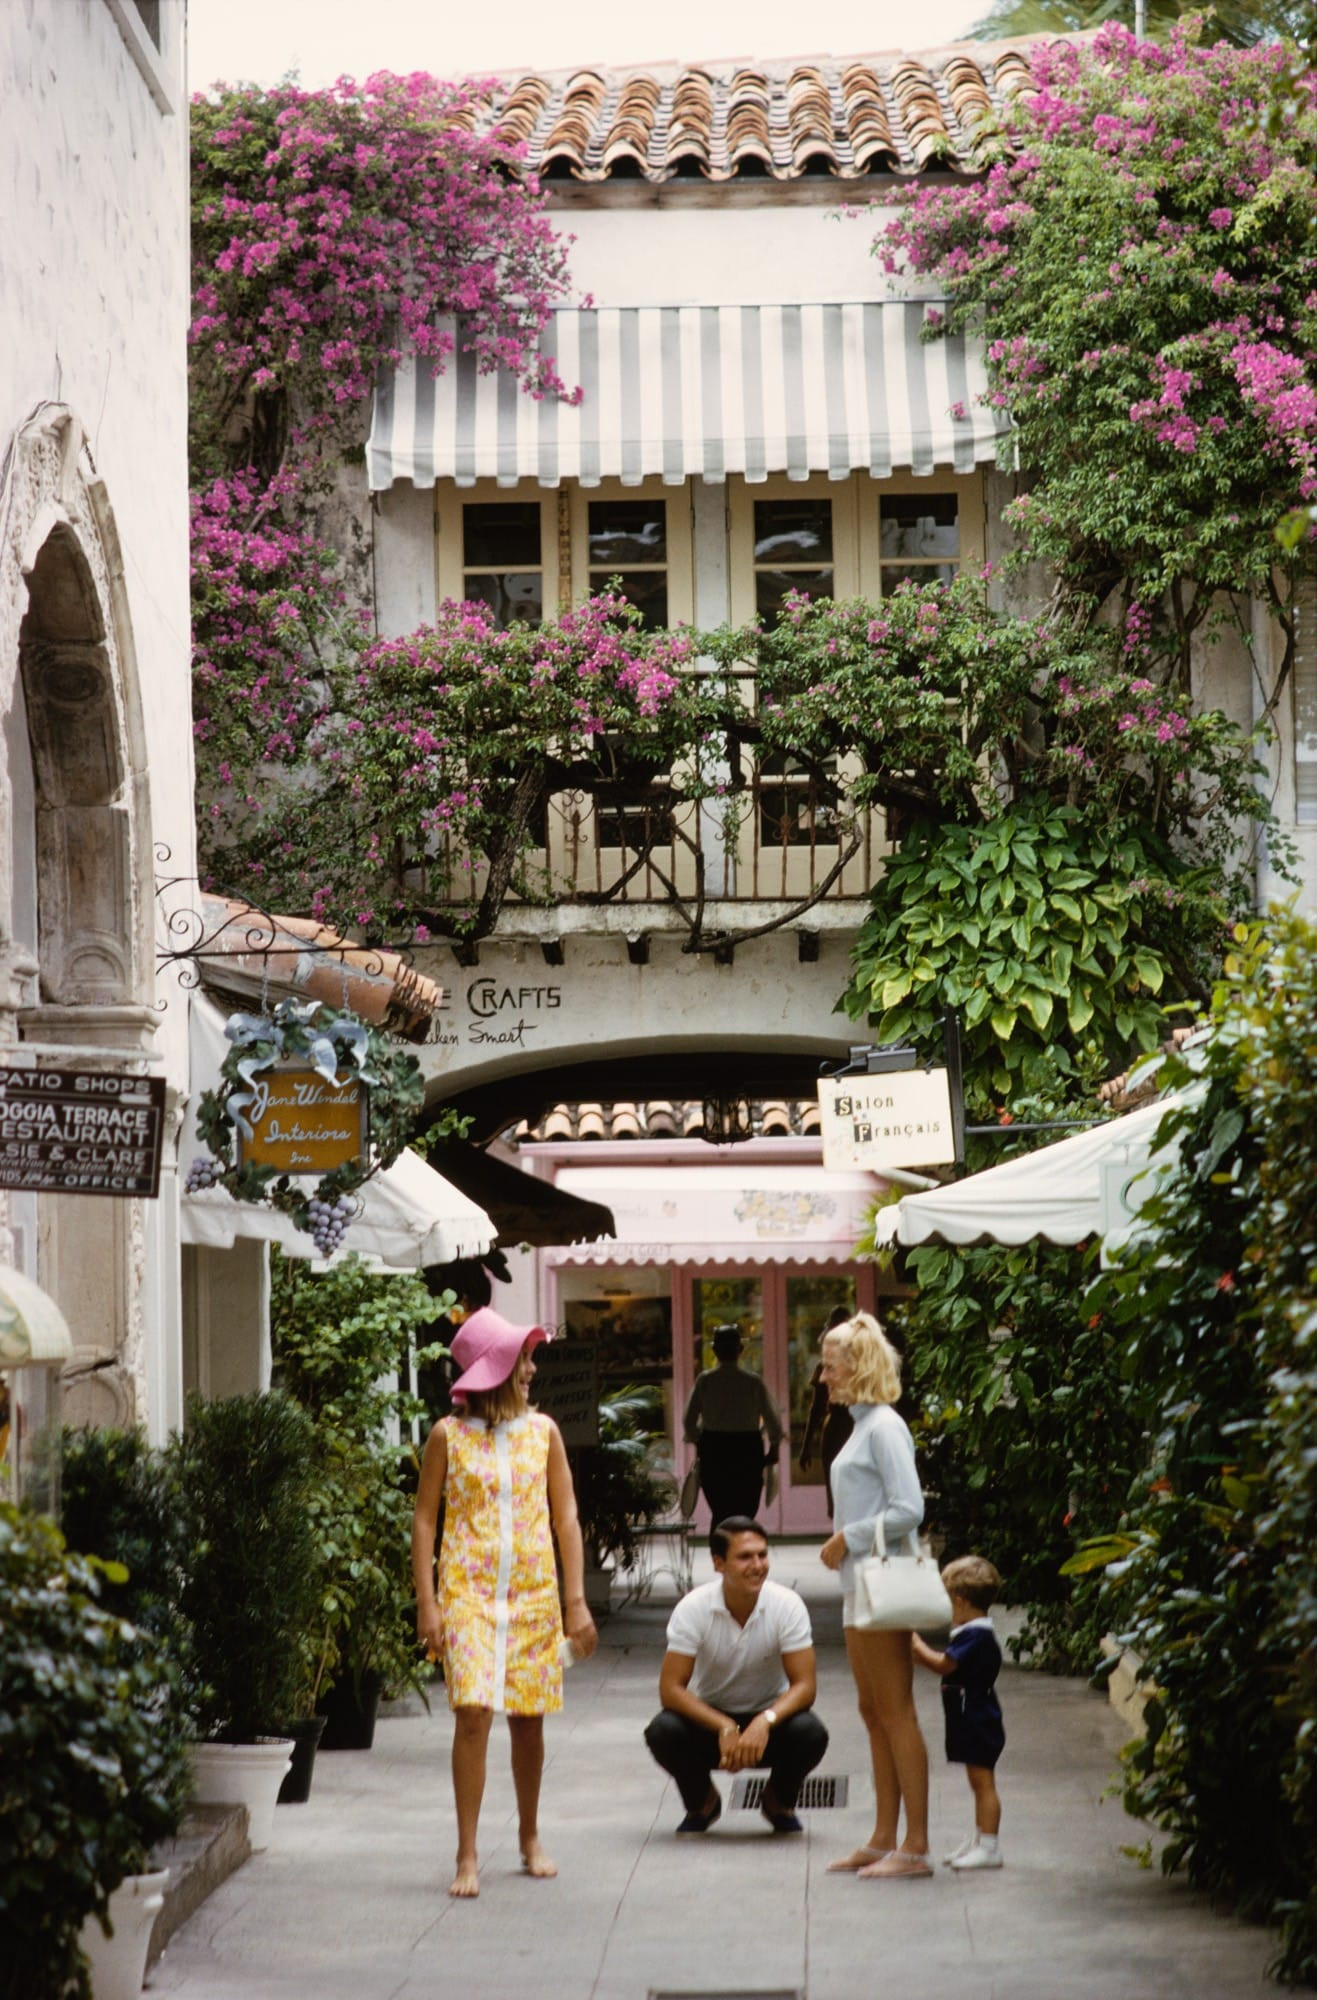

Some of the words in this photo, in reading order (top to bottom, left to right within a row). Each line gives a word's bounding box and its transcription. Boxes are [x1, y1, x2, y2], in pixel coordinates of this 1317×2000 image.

[467, 977, 562, 1018] CRAFTS
[468, 1020, 538, 1048] Smart
[75, 1076, 151, 1094] SHOPS
[250, 1081, 297, 1124] Jane
[835, 1096, 895, 1116] Salon
[0, 1101, 57, 1122] OGGIA
[62, 1105, 149, 1129] TERRACE
[0, 1121, 150, 1147] ESTAURANT
[263, 1120, 352, 1143] Interiors
[854, 1121, 941, 1143] Français
[0, 1142, 40, 1161] SIE
[49, 1144, 65, 1161] &
[76, 1148, 146, 1165] CLARE
[65, 1174, 137, 1190] OFFICE
